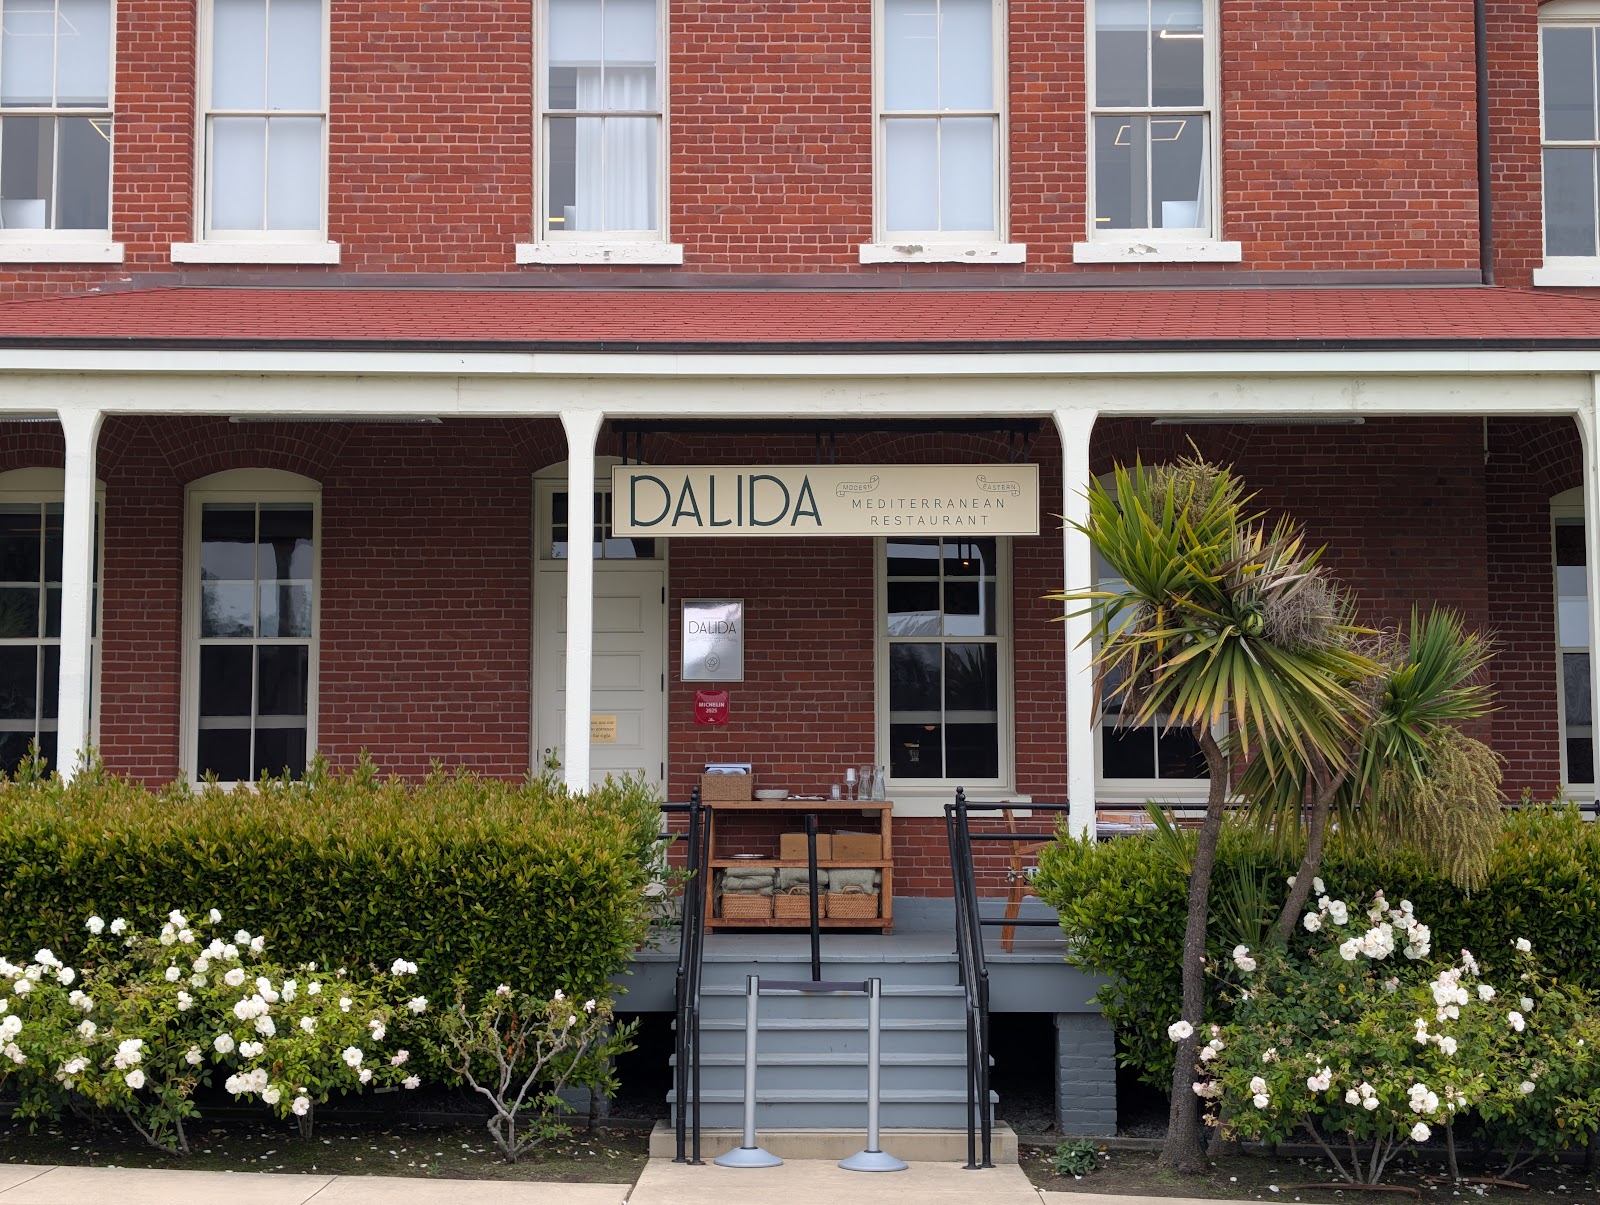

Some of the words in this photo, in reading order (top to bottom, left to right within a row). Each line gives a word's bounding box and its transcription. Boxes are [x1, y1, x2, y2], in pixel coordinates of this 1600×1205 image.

[842, 483, 873, 491] MODERN
[982, 483, 1016, 491] EASTERN
[630, 474, 822, 527] DALIDA
[852, 498, 1005, 509] MEDITERRANEAN
[870, 515, 989, 526] RESTAURANT
[688, 620, 737, 634] DALIDA
